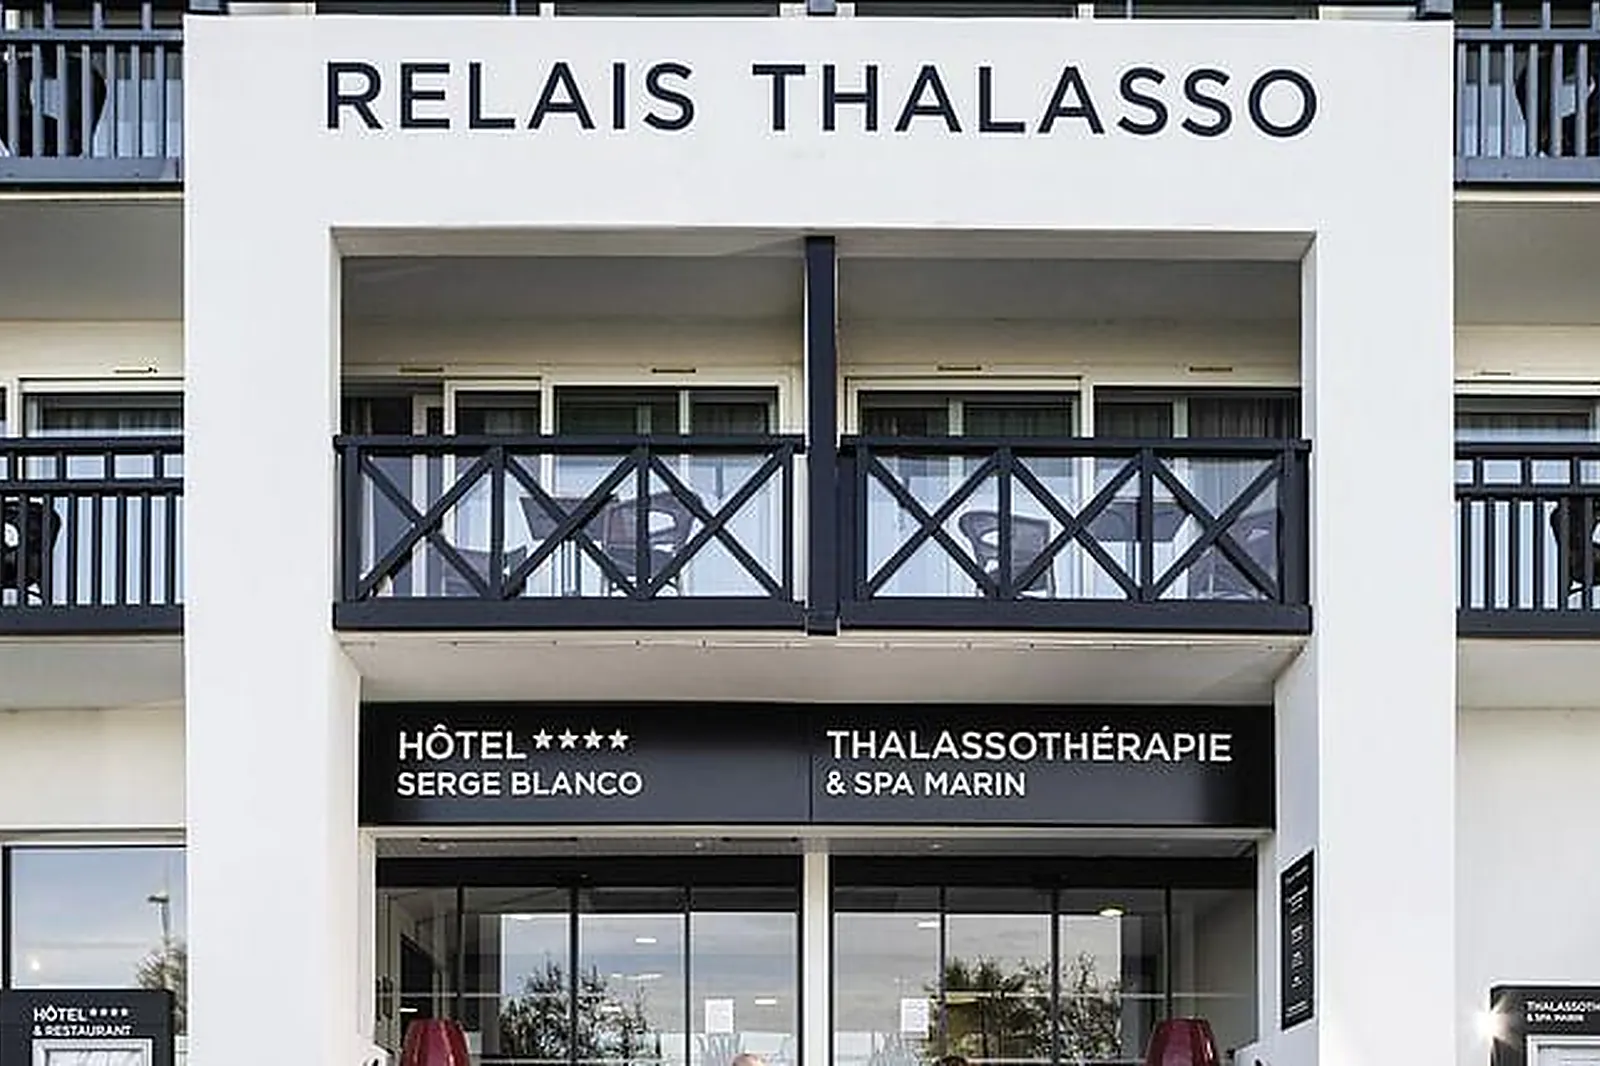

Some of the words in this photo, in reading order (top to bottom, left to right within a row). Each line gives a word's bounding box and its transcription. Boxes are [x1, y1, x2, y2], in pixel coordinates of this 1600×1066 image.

[327, 61, 695, 130] RELAIS
[753, 64, 1318, 137] THALASSO
[398, 724, 527, 761] HÔTEL
[827, 725, 1233, 763] THALASSOTHÉRAPIE
[397, 771, 501, 797] SERGE
[511, 771, 643, 797] BLANCO
[826, 771, 847, 796] &
[854, 771, 914, 797] SPA
[924, 772, 1026, 798] MARIN
[33, 1005, 88, 1022] HÔTEL
[33, 1025, 43, 1036] &
[45, 1025, 132, 1037] RESTAURANT
